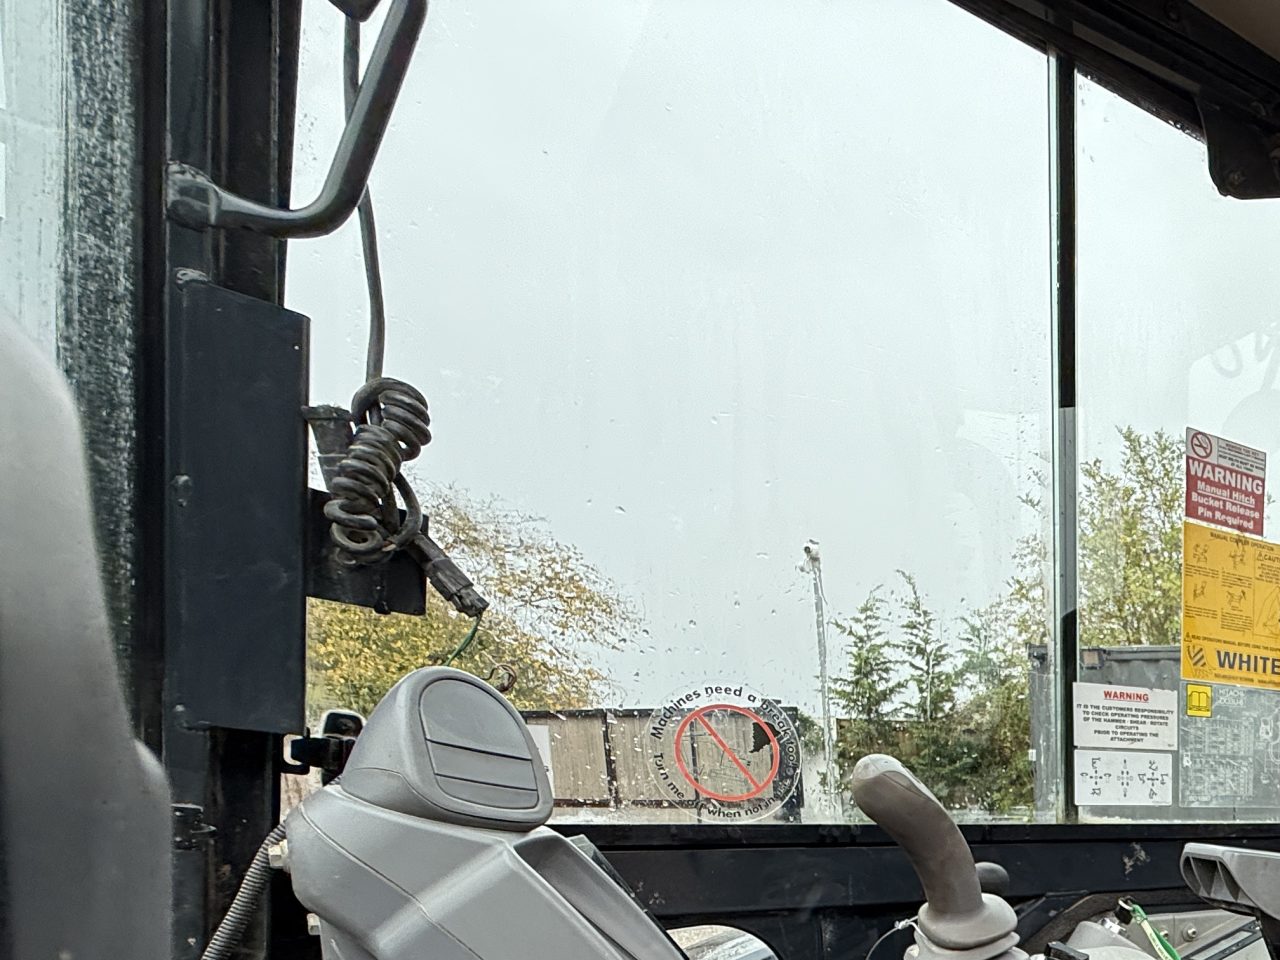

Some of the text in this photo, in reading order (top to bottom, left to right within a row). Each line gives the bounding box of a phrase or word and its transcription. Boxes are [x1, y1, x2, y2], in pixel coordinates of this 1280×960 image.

[1189, 459, 1263, 494] WARNING
[1191, 491, 1260, 519] Bucket Release
[1197, 480, 1255, 505] Manual Hitch
[1198, 506, 1254, 529] Pin Required
[1103, 690, 1149, 701] WARNING
[650, 689, 701, 740] Machines
[704, 685, 743, 697] need
[748, 694, 757, 702] a
[760, 699, 791, 736] break
[653, 752, 669, 780] Turn
[667, 781, 685, 800] me
[707, 807, 741, 817] when
[745, 805, 762, 816] not
